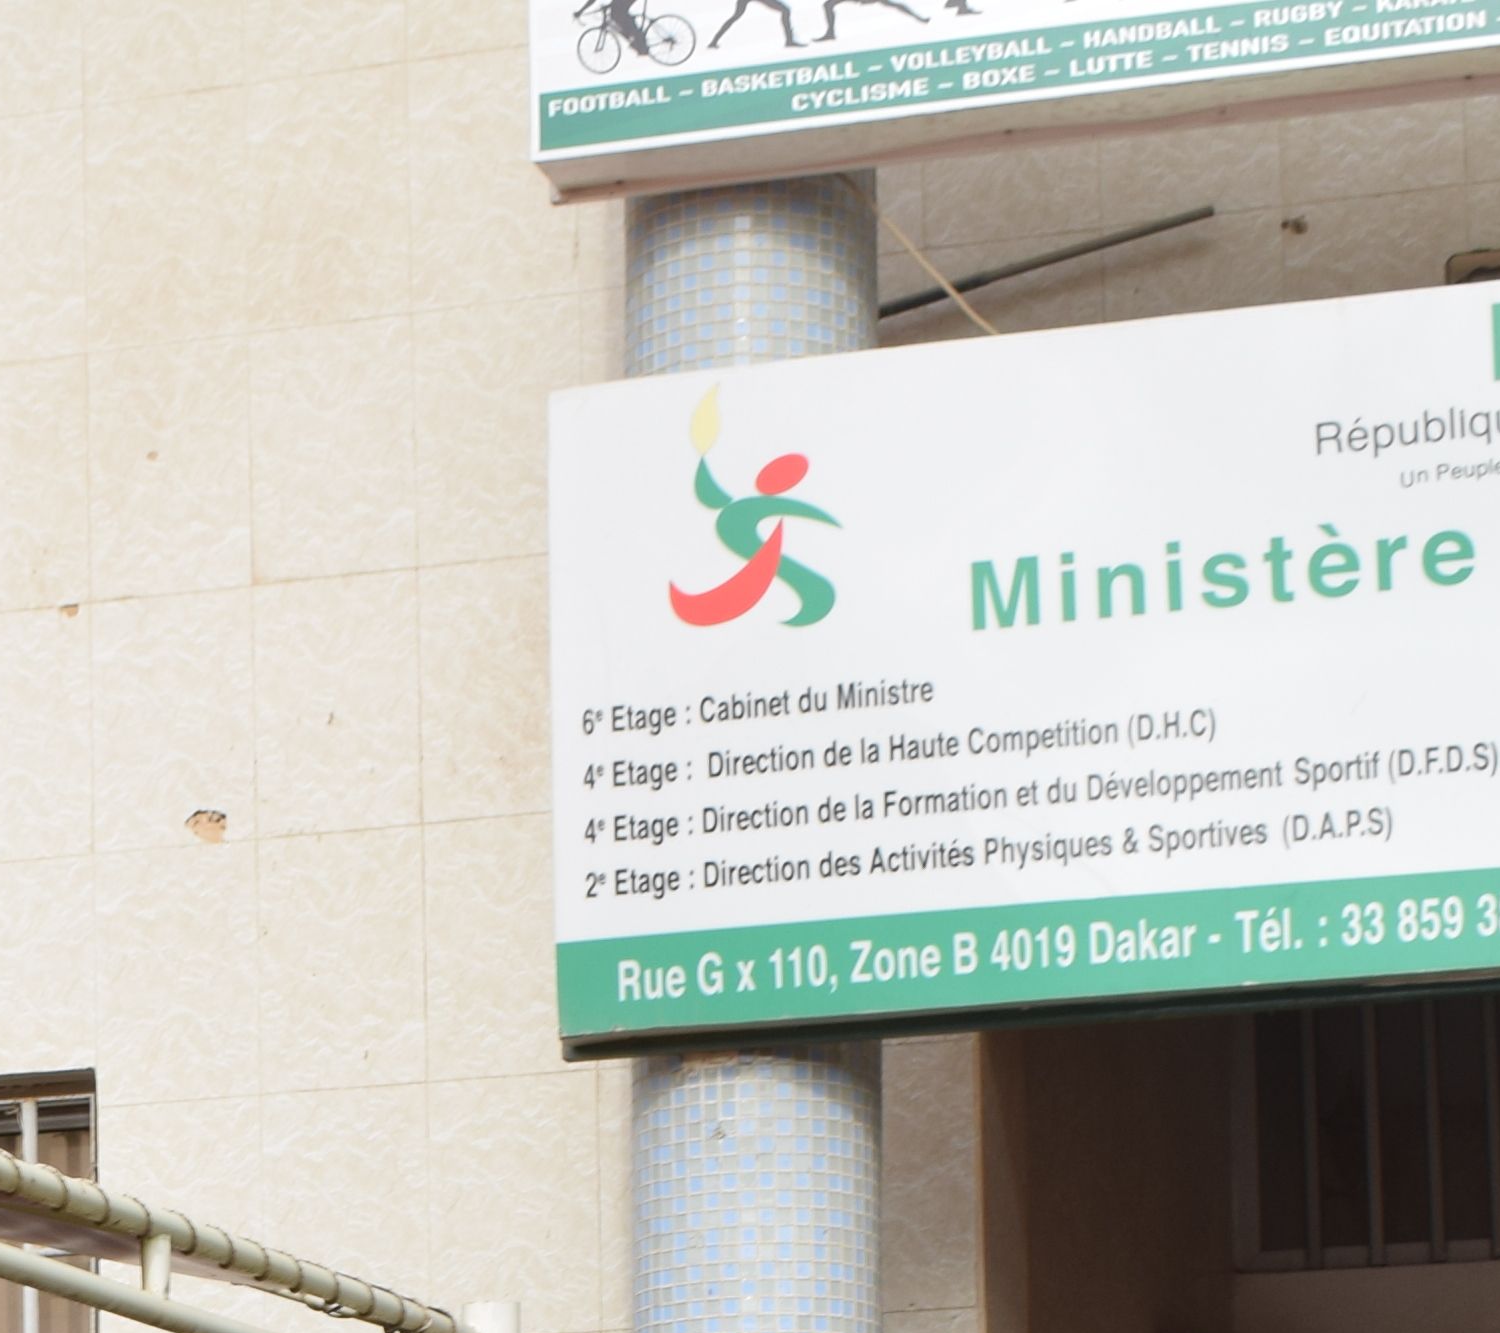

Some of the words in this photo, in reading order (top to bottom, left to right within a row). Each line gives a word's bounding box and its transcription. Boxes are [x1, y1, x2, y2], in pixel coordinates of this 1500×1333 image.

[548, 85, 670, 117] FOOTBALL
[701, 60, 860, 98] BASKETBALL
[890, 36, 1052, 73] VOLLEYBALL
[1083, 14, 1221, 50] HANDBALL
[1253, 0, 1344, 28] RUGBY
[792, 77, 928, 111] CYCLISME
[963, 63, 1034, 90] BOXE
[1069, 49, 1152, 77] LUTTE
[1187, 33, 1289, 63] TENNIS
[1324, 9, 1487, 47] EQUITATION
[1399, 468, 1430, 490] Un
[970, 521, 1476, 632] Ministère
[611, 704, 677, 738] Etage
[699, 689, 791, 725] Cabinet
[797, 685, 828, 715] du
[836, 678, 934, 711] Ministre
[612, 758, 678, 792] Etage
[707, 743, 815, 780] Direction
[822, 739, 853, 769] de
[860, 736, 880, 765] la
[888, 731, 960, 763] Haute
[967, 717, 1118, 759] Competition
[1127, 708, 1216, 743] (D.H.C)
[613, 813, 680, 848] Etage
[702, 799, 809, 836] Direction
[817, 795, 847, 825] de
[854, 792, 875, 822] la
[883, 782, 1008, 819] Formation
[1016, 779, 1039, 808] et
[1046, 776, 1077, 806] du
[1087, 760, 1283, 804] Développement
[1294, 749, 1380, 792] Sportif
[1388, 741, 1499, 781] (D.F.D.S)
[614, 867, 681, 901] Etage
[703, 854, 811, 890] Direction
[818, 849, 862, 880] des
[869, 838, 976, 875] Activités
[984, 832, 1113, 871] Physiques
[1122, 825, 1139, 856] &
[1148, 819, 1268, 860] Sportives
[1282, 806, 1393, 845] (D.A.P.S)
[618, 958, 686, 1001] Rue
[697, 951, 724, 996] G
[737, 959, 756, 993] x
[769, 943, 838, 991] 110,
[850, 938, 942, 983] Zone
[953, 931, 979, 976] B
[990, 924, 1077, 971] 4019
[1089, 917, 1197, 966] Dakar
[1234, 906, 1304, 954] Tél.
[1341, 900, 1386, 947] 33
[1397, 894, 1465, 943] 859
